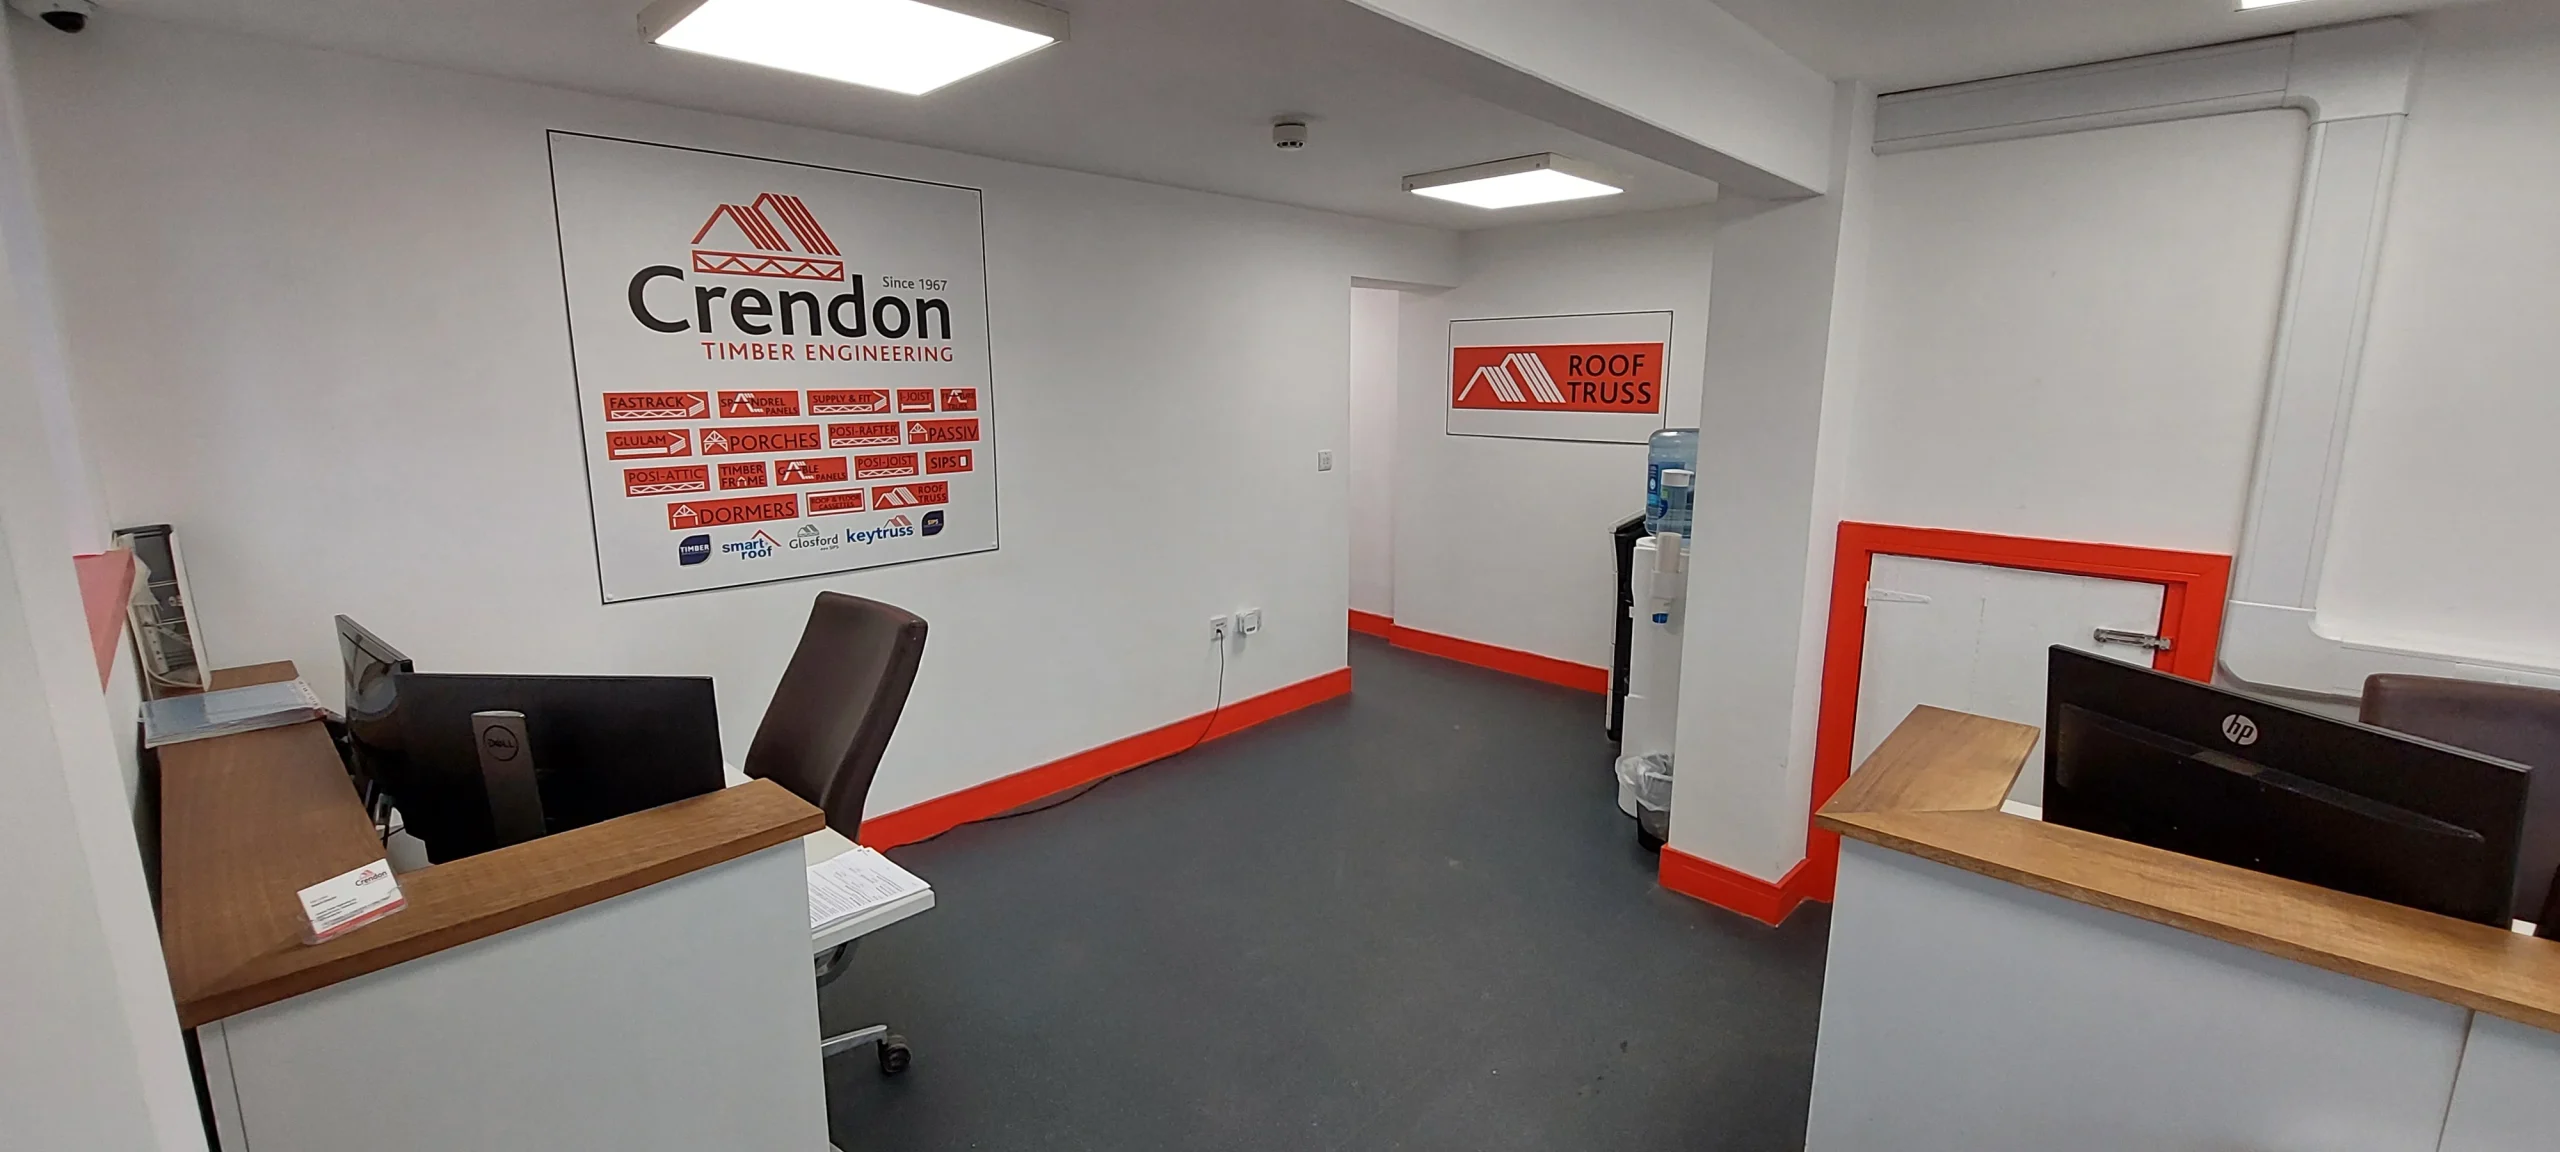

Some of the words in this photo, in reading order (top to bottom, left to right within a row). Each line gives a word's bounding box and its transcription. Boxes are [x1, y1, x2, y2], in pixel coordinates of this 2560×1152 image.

[882, 276, 915, 290] Since
[919, 278, 948, 292] 1967
[628, 265, 952, 340] Crendon
[701, 342, 796, 361] TIMBER
[807, 344, 954, 362] ENGINEERING
[1568, 354, 1646, 377] ROOF
[812, 394, 847, 404] SUPPLY
[849, 394, 856, 403] &
[858, 393, 872, 403] FIT
[900, 391, 930, 402] I-JOIST
[1567, 381, 1651, 405] TRUSS
[609, 396, 685, 409] FASTRACK
[765, 406, 798, 415] PANELS
[830, 424, 898, 437] POSI-RAFTER
[929, 424, 979, 441] PASSIV
[613, 435, 667, 447] GLULAM
[729, 432, 820, 451] PORCHES
[857, 455, 913, 468] POSI-JOIST
[930, 456, 957, 469] SIPS
[628, 468, 705, 483] POSI-ATTIC
[721, 464, 764, 476] TIMBER
[815, 471, 847, 481] PANELS
[721, 476, 766, 488] FRAME
[918, 484, 944, 494] ROOF
[918, 492, 948, 502] TRUSS
[701, 501, 796, 525] DORMERS
[788, 533, 839, 549] Glosford
[846, 525, 914, 545] keytruss
[680, 543, 710, 553] TIMBER
[721, 538, 765, 554] smart
[741, 545, 773, 560] roof
[2226, 714, 2255, 744] hp
[487, 738, 515, 748] DELL
[355, 871, 388, 887] Crendon
